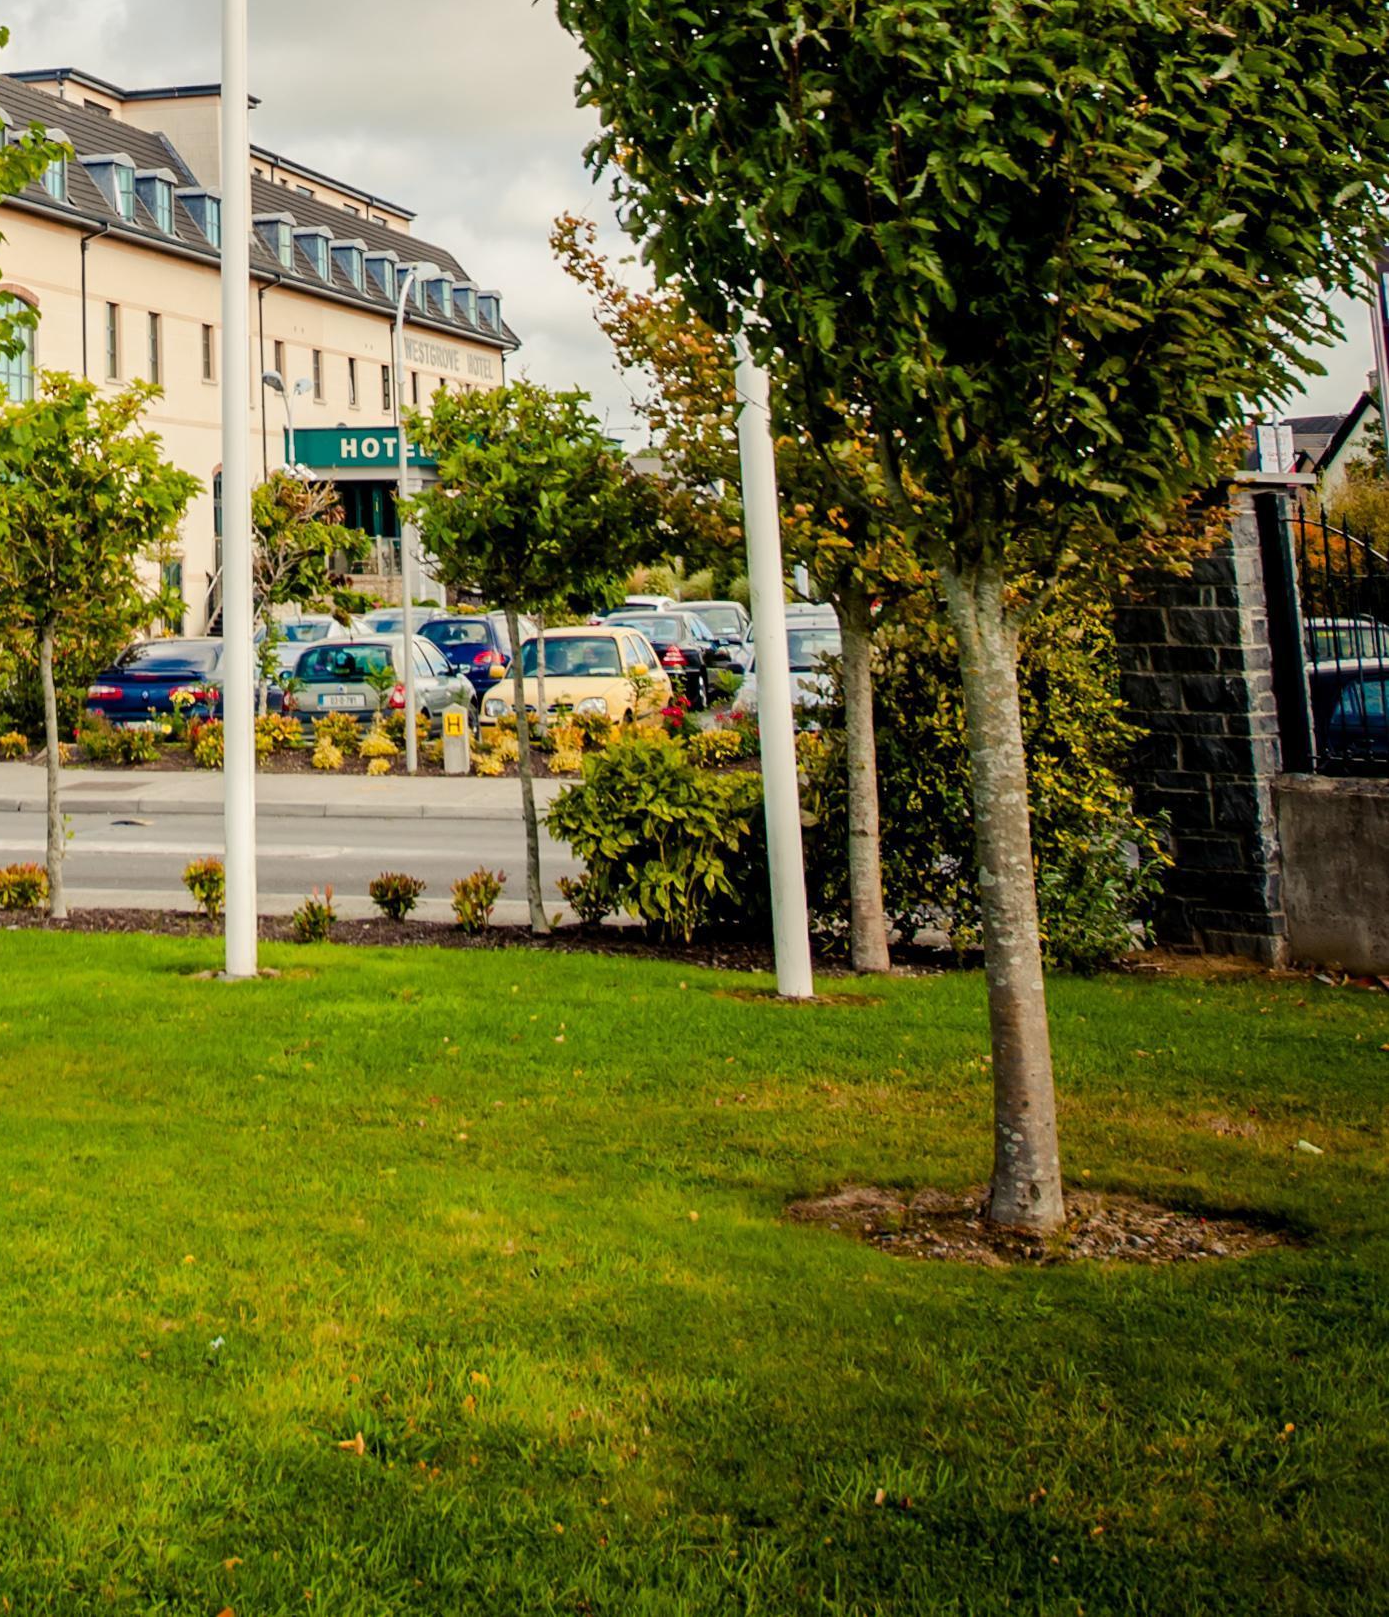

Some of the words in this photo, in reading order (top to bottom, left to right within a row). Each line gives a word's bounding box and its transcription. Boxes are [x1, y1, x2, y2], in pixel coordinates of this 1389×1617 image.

[404, 337, 459, 372] WESTGROVE
[467, 353, 494, 380] HOTEL
[446, 715, 460, 732] H
